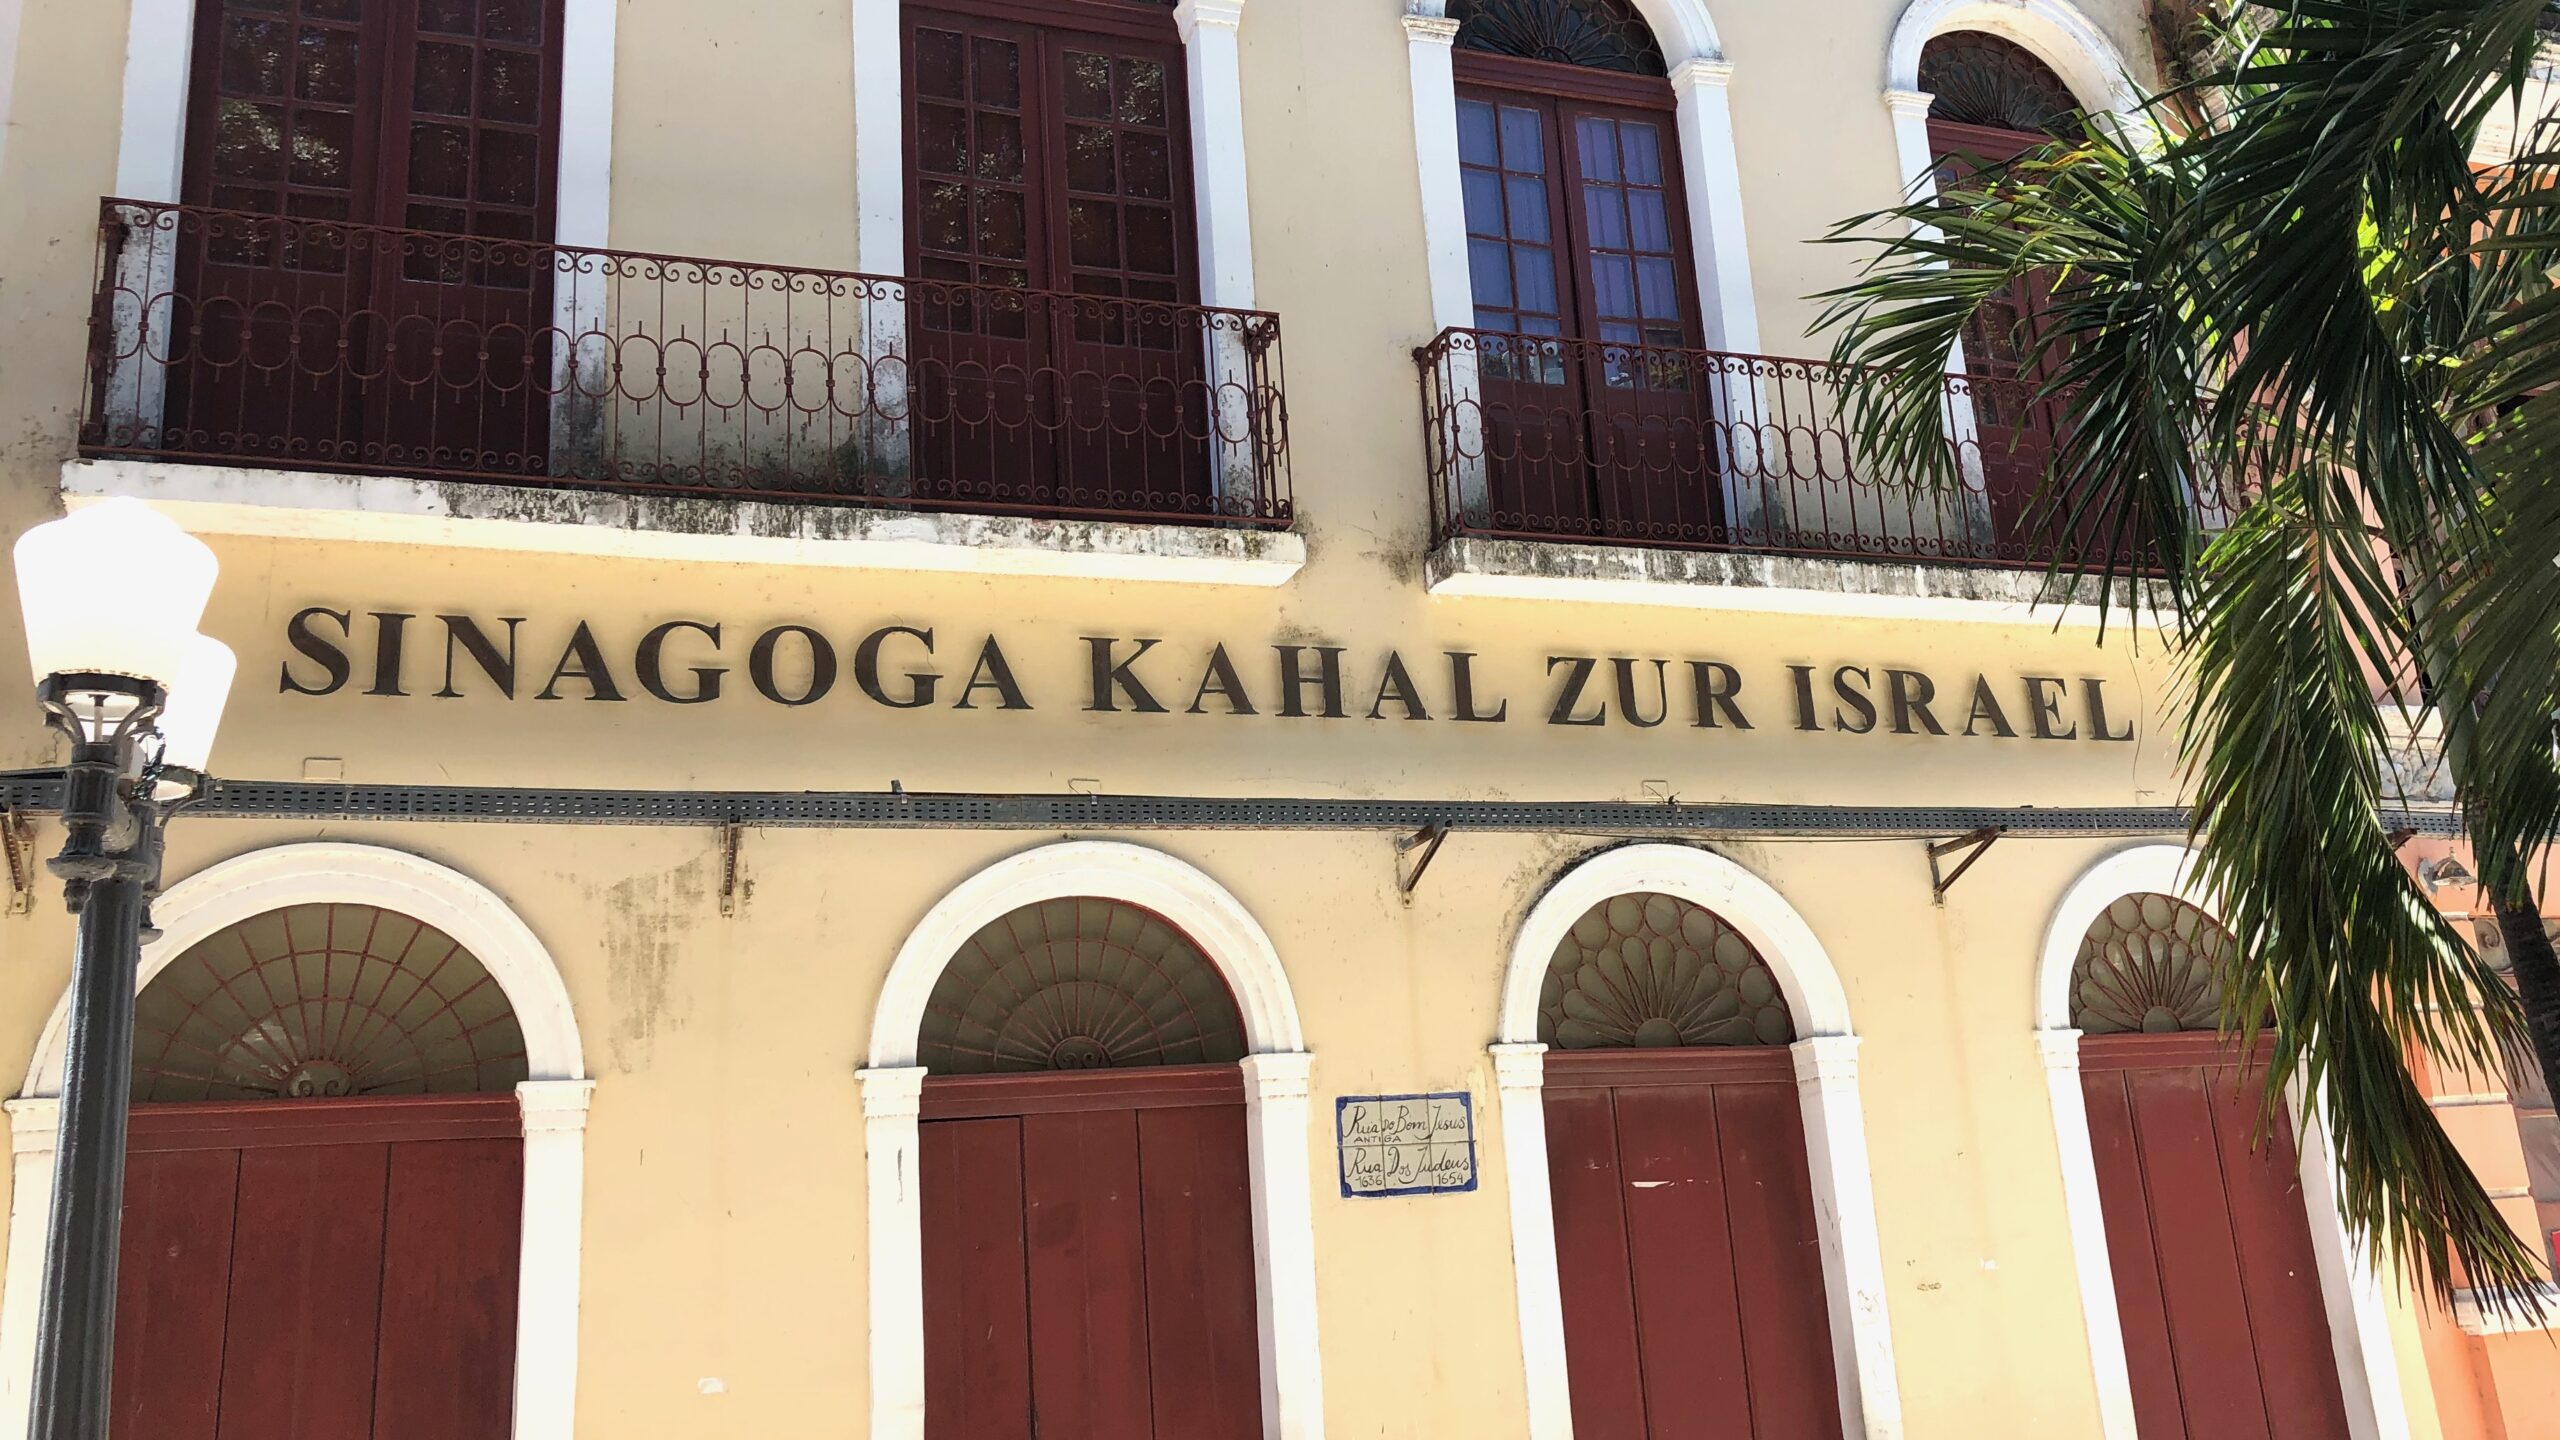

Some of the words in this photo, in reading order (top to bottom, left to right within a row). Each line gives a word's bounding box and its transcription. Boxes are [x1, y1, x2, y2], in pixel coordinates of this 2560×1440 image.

[279, 606, 1034, 711] SINAGOGA
[1079, 636, 1508, 722] KAHAL
[1546, 655, 1755, 730] ZUR
[1786, 664, 2135, 742] ISRAEL
[1343, 1105, 1380, 1138] Rua
[1391, 1105, 1427, 1135] Bom
[1414, 1105, 1466, 1140] Jesus
[1353, 1135, 1402, 1143] ANTIGA
[1346, 1147, 1383, 1178] Rua
[1398, 1146, 1470, 1184] Judeus
[1355, 1174, 1383, 1188] 1636
[1437, 1172, 1464, 1185] 1654
